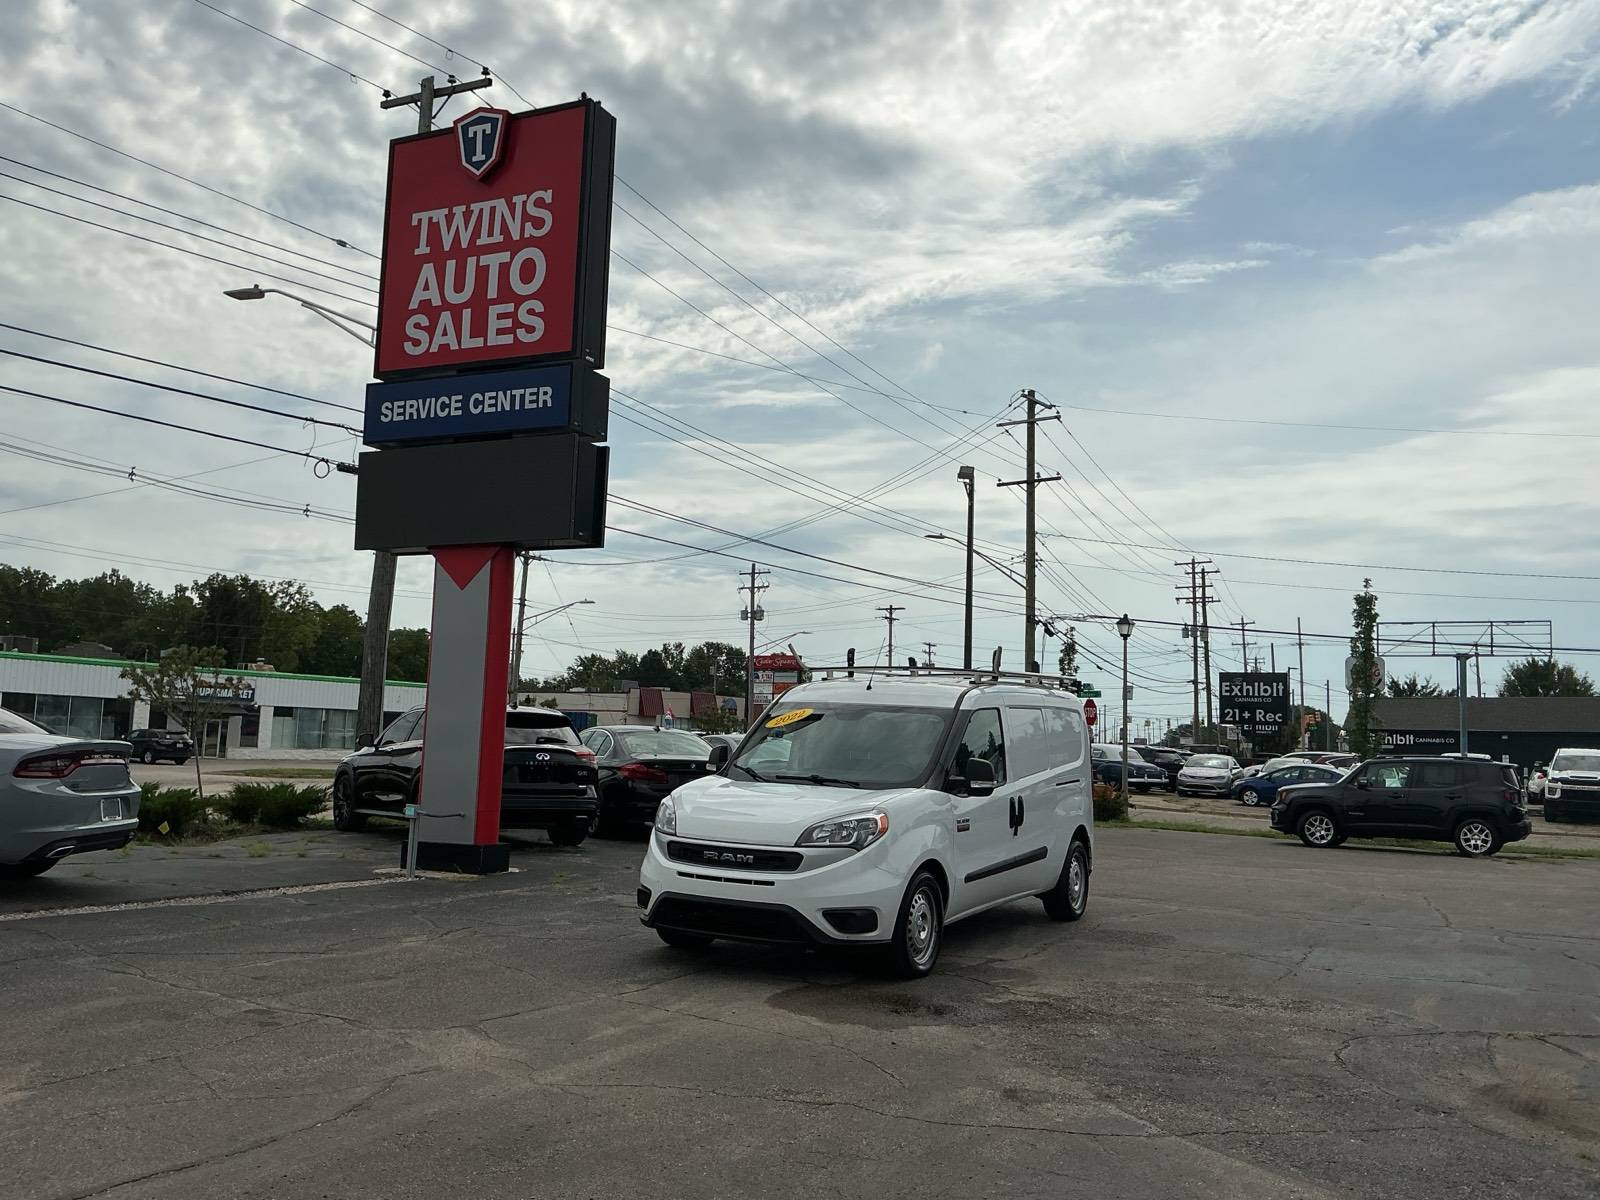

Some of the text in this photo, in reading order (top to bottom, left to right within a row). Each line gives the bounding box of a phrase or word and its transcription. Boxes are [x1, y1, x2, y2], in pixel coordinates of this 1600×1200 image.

[467, 122, 492, 162] T
[411, 189, 553, 256] TWINS
[408, 247, 547, 310] AUTO
[403, 299, 545, 356] SALES
[380, 386, 553, 423] SERVICE CENTER
[774, 710, 807, 726] 2022
[1084, 707, 1098, 718] STOP
[1255, 709, 1283, 722] Rec
[703, 850, 755, 864] RAM
